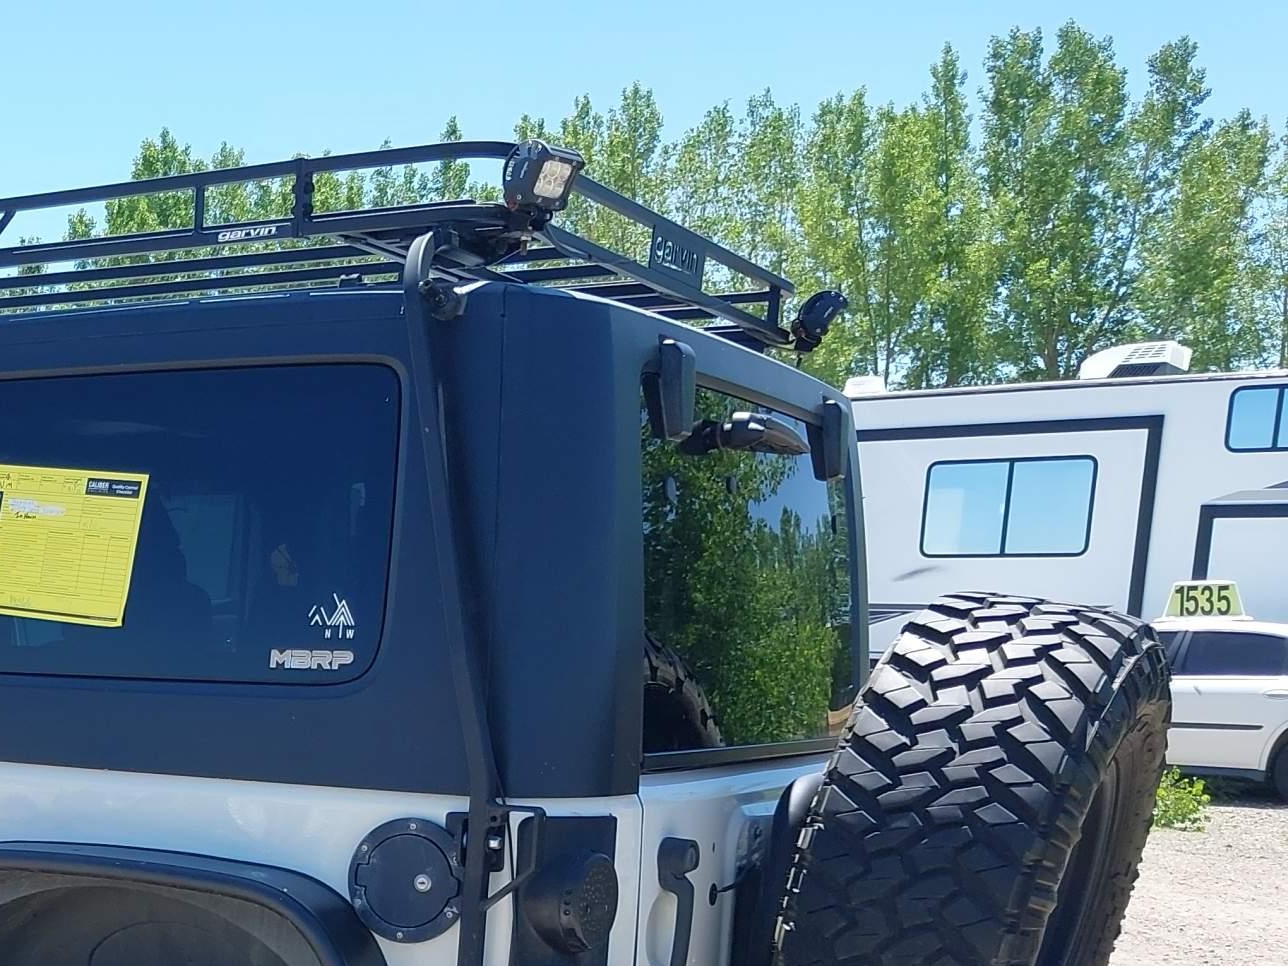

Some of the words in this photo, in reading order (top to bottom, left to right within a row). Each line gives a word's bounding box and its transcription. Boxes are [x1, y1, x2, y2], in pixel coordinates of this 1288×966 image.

[217, 226, 277, 242] garvin
[1175, 585, 1231, 616] 1535
[269, 648, 354, 670] MBRP
